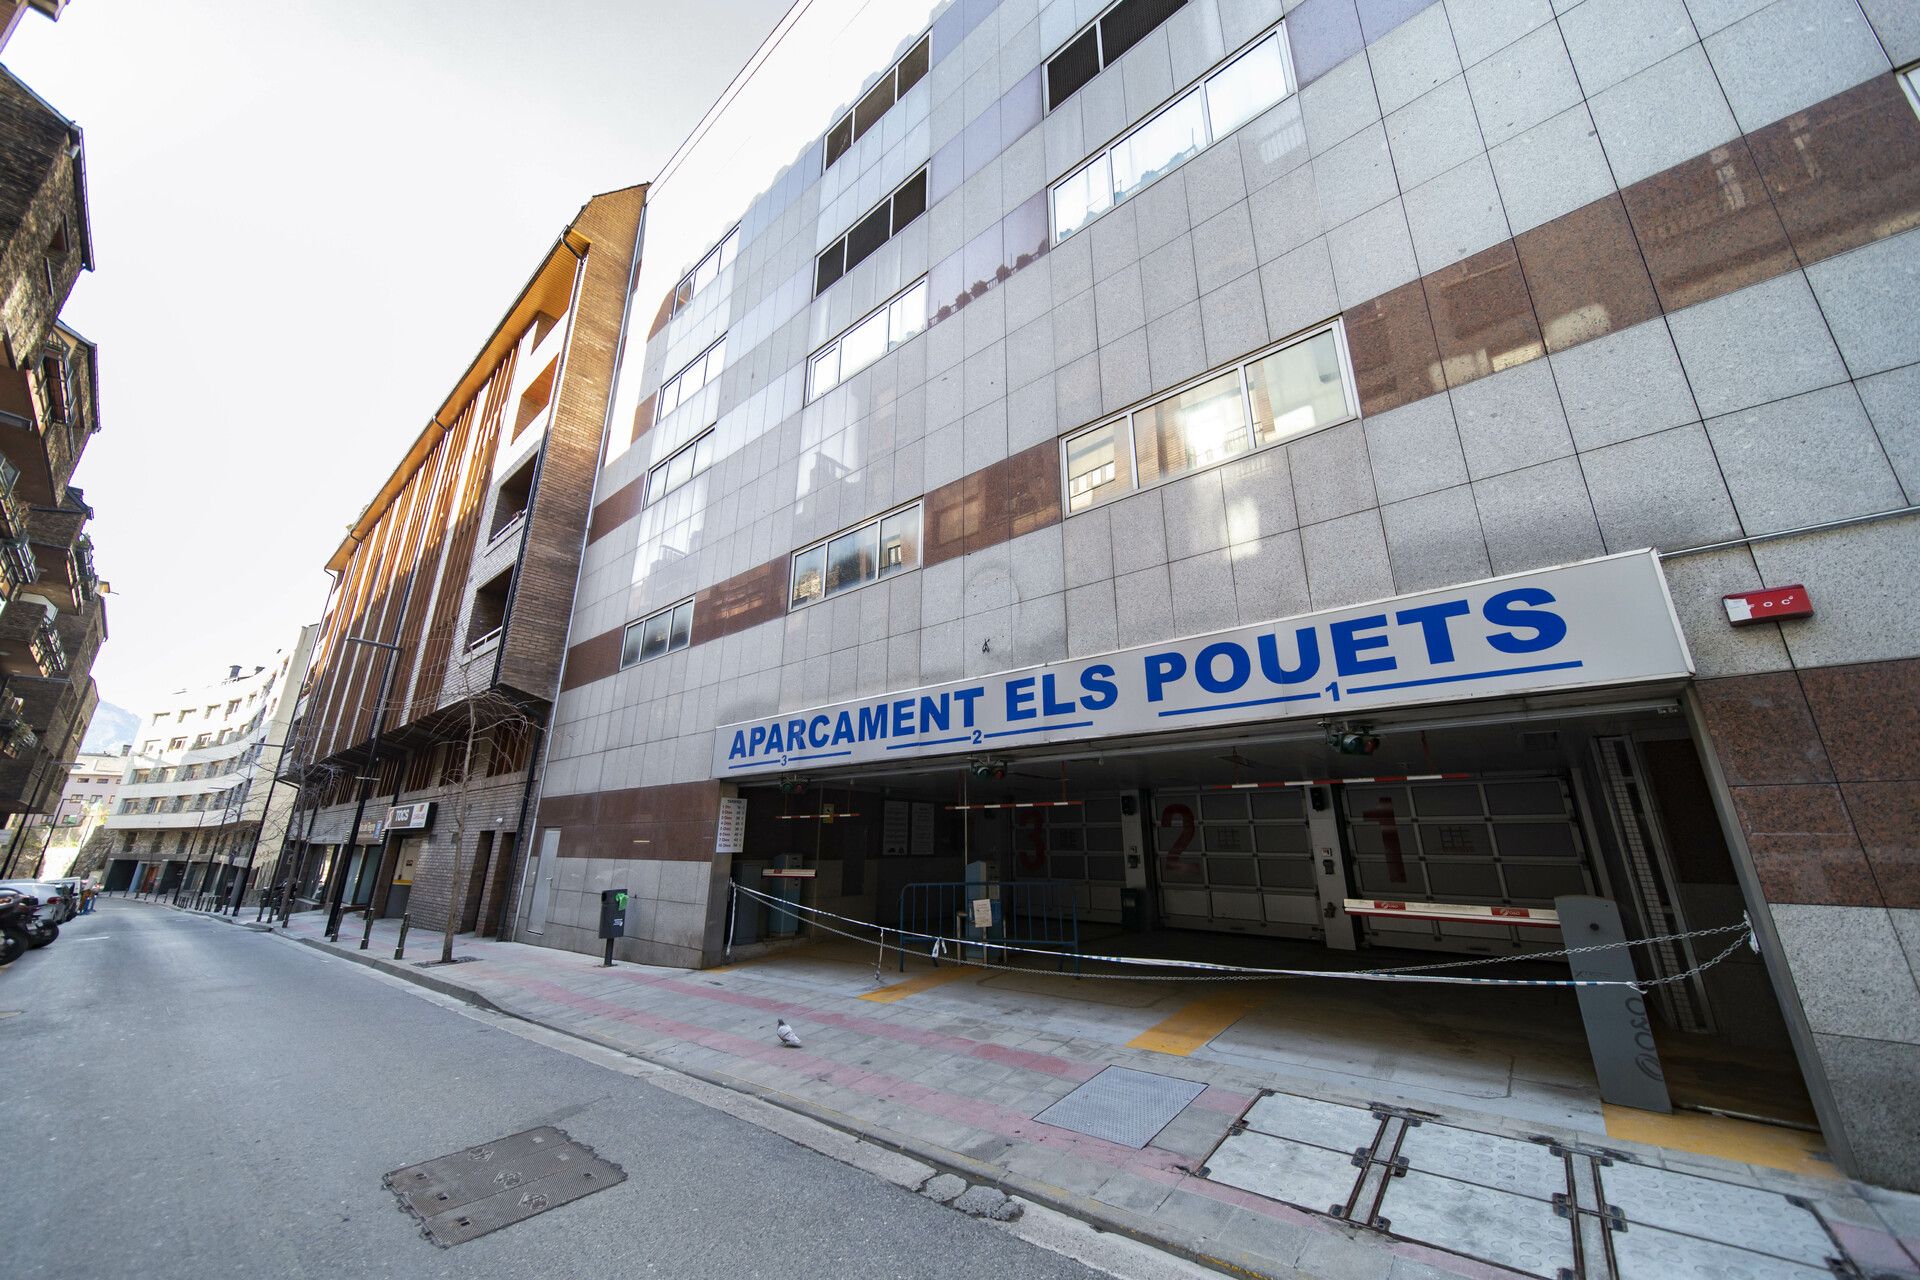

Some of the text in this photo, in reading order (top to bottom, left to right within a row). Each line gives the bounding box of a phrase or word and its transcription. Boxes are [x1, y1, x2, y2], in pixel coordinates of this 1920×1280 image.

[729, 588, 1567, 760] APARCAMENT ELS POUETS
[1325, 682, 1340, 702] 1
[781, 755, 788, 767] 3
[972, 730, 982, 744] 2
[1017, 809, 1046, 871] 3
[1160, 803, 1200, 874] 2
[1363, 797, 1407, 883] 1
